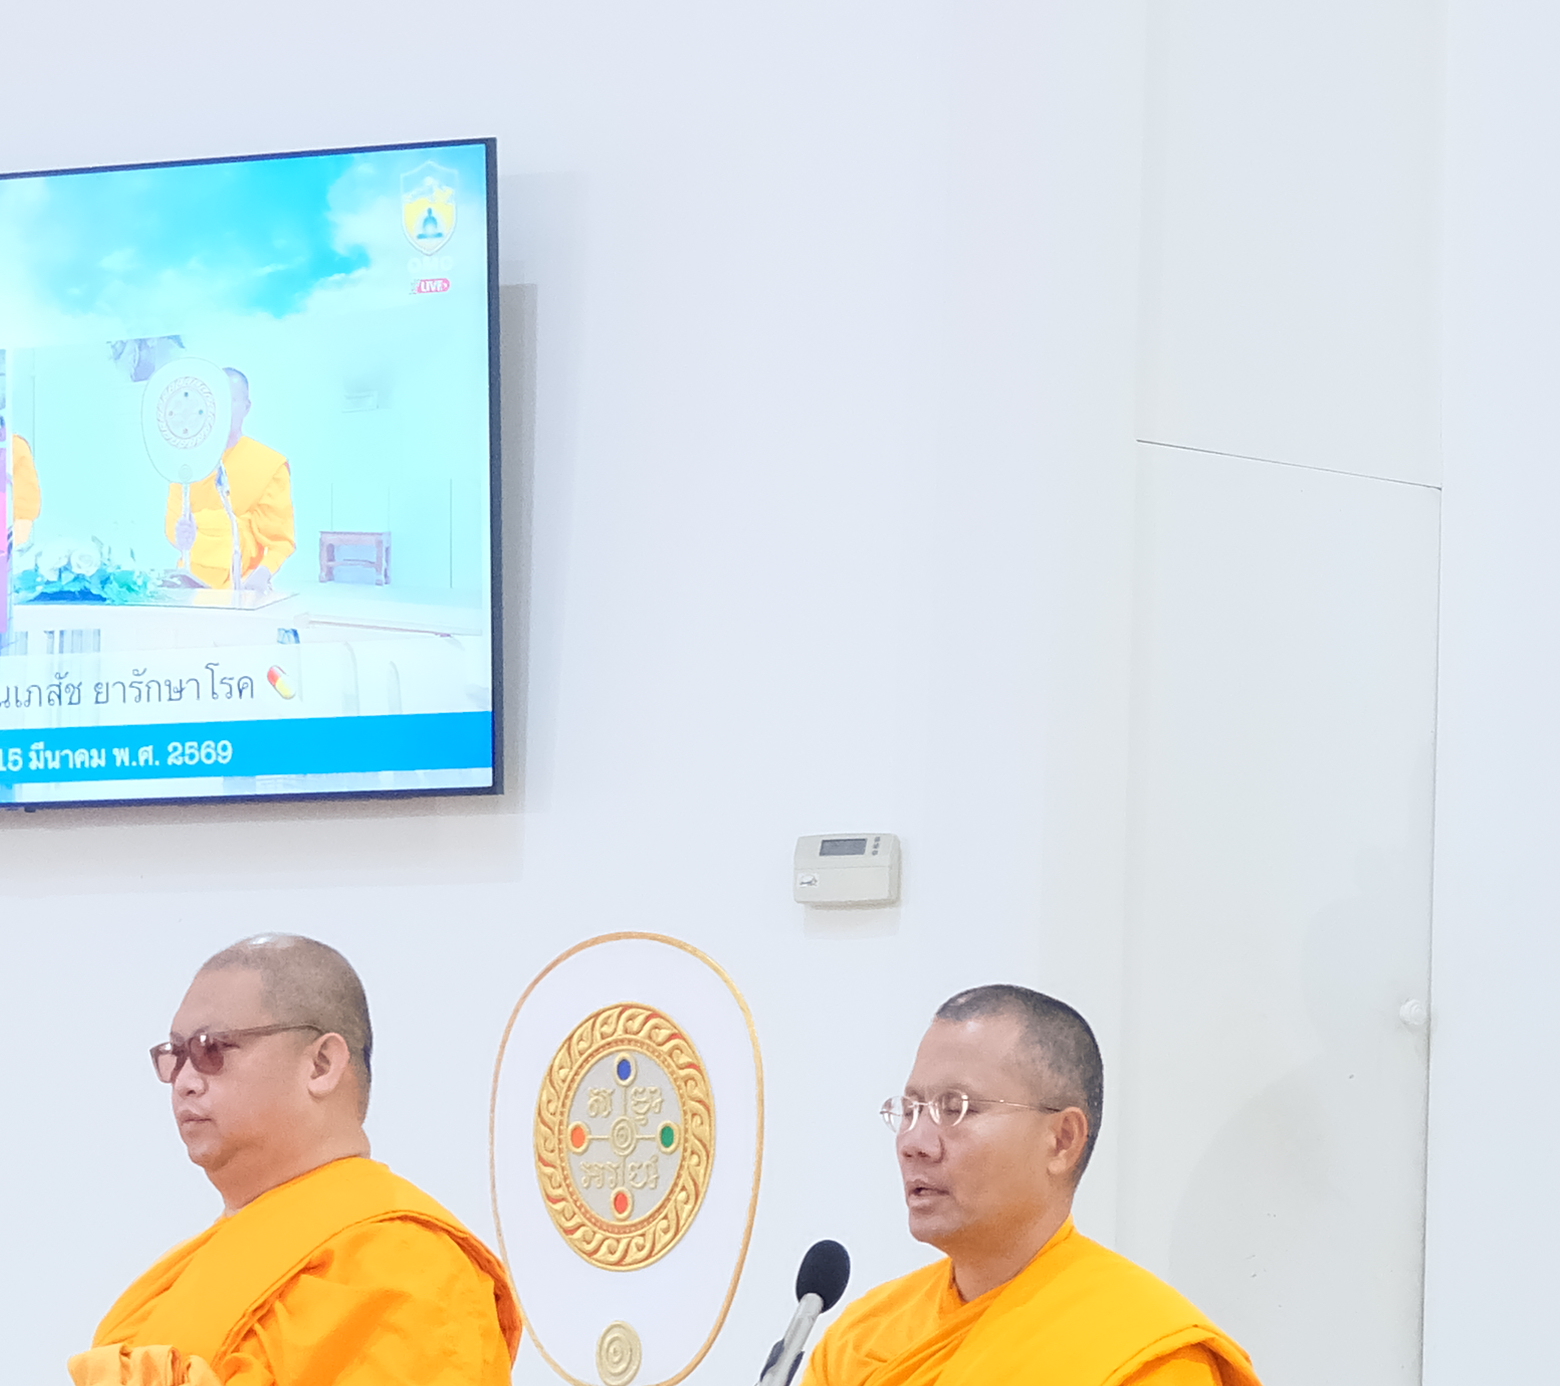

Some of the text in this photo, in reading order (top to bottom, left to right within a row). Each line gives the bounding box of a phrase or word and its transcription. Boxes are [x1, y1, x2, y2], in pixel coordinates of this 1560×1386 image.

[28, 741, 106, 770] มีนาคม
[112, 745, 161, 768] พ.ศ.
[167, 740, 233, 766] 2569
